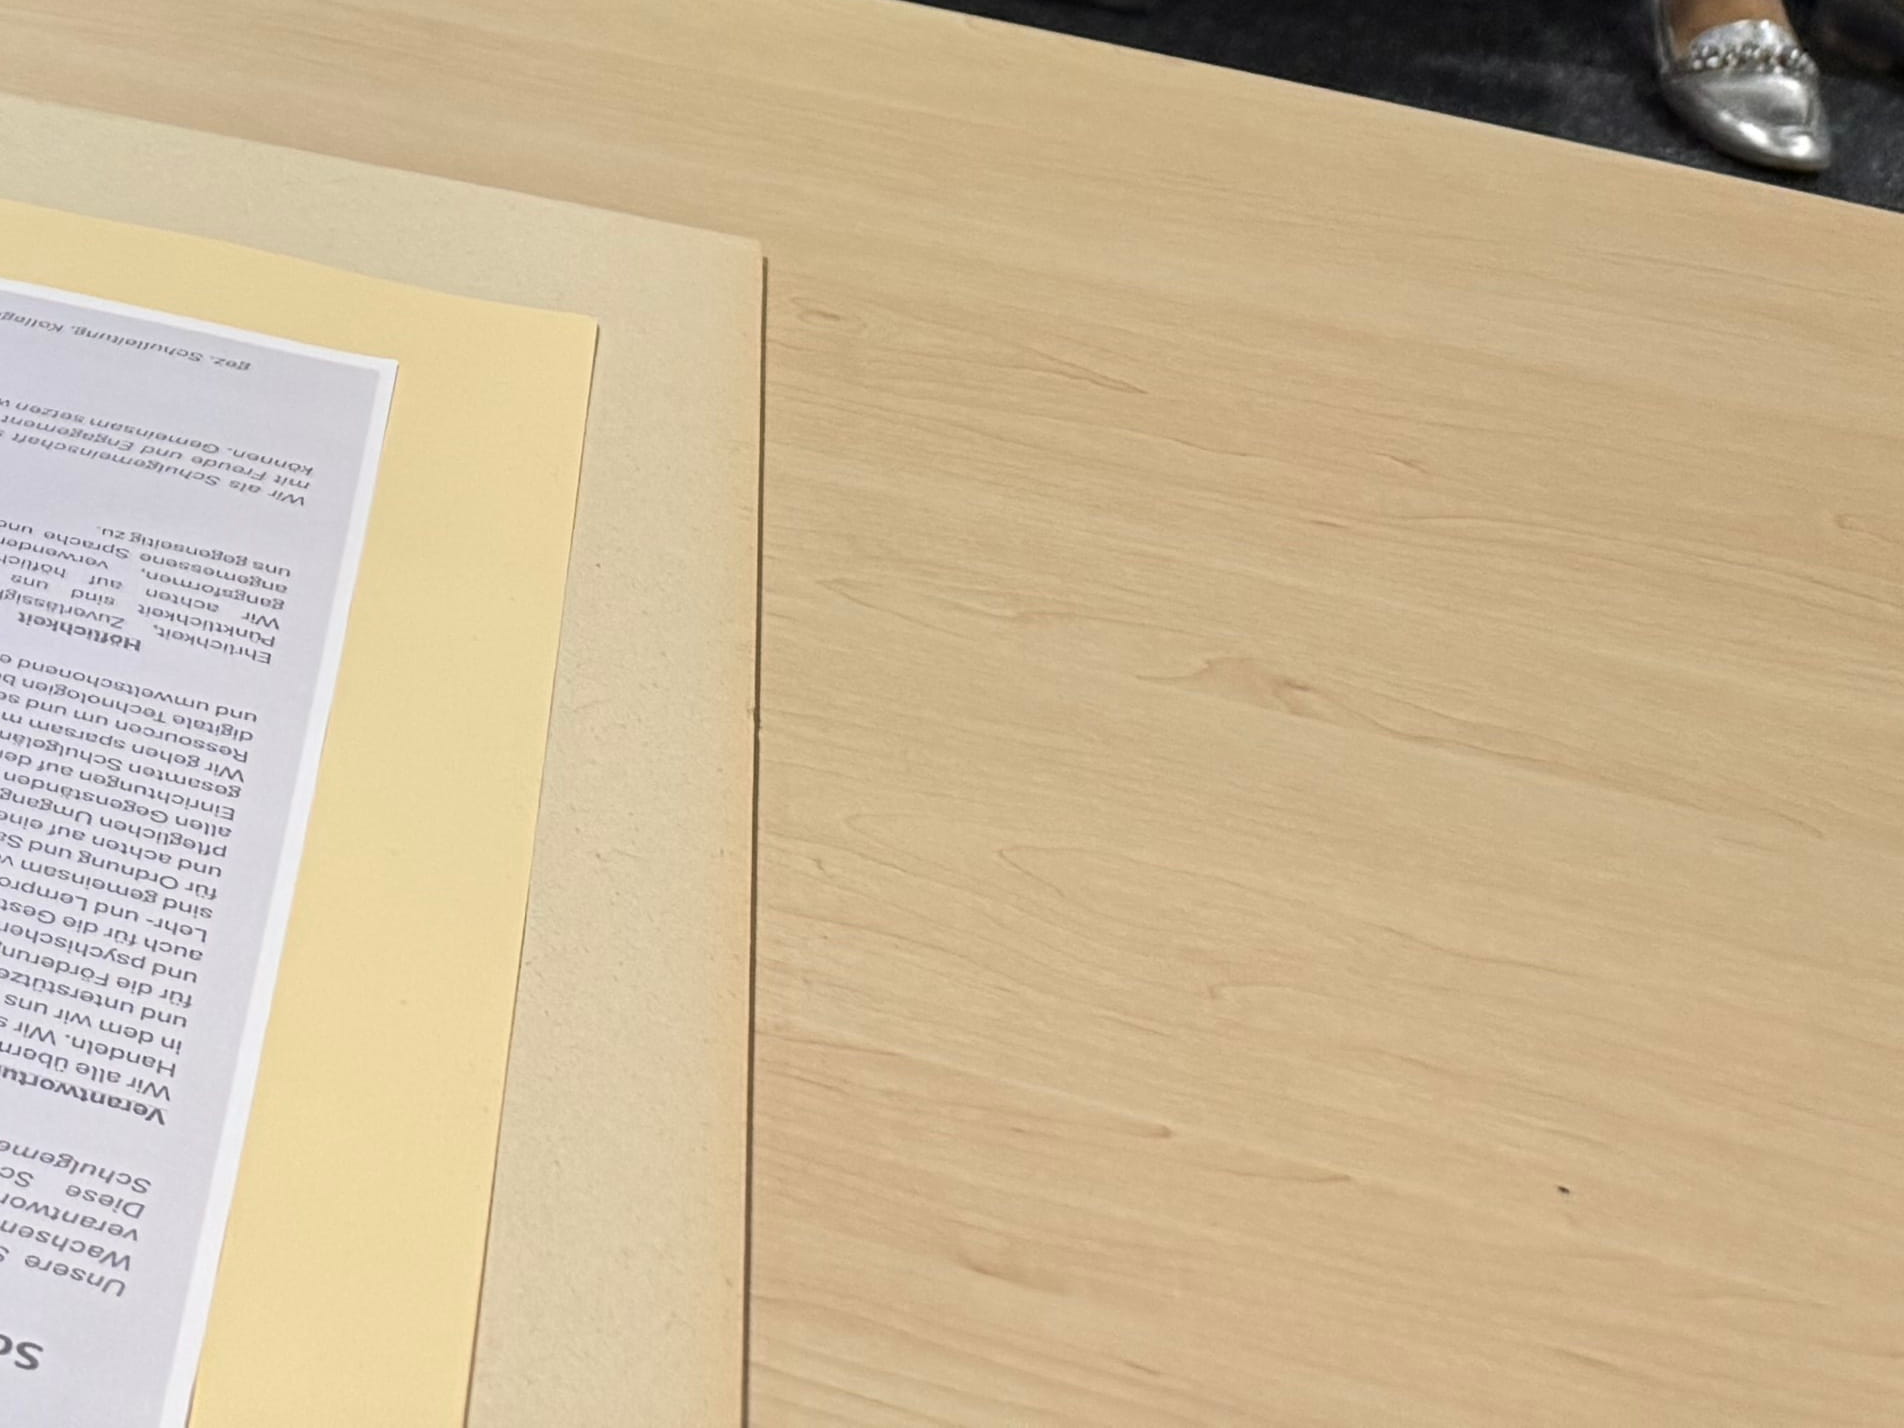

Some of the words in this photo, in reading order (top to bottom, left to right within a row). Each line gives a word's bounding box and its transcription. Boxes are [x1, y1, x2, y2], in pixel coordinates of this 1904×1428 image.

[17, 611, 142, 652] Höflichkeit
[22, 677, 167, 724] Technologien
[25, 698, 67, 716] und
[73, 709, 109, 727] um
[172, 714, 254, 743] digitale
[28, 718, 126, 750] sparsam
[115, 719, 248, 764] Ressourcen
[131, 743, 201, 768] gehen
[36, 760, 74, 777] auf
[204, 762, 245, 784] Wir
[128, 763, 242, 799] gesamten
[3, 771, 169, 824] Gegenständen
[79, 770, 236, 822] Einrichtungen
[47, 824, 86, 841] auf
[99, 816, 228, 858] pfleglichen
[175, 815, 232, 838] allen
[28, 839, 73, 860] und
[92, 835, 172, 865] achten
[77, 849, 179, 890] Ordnung
[176, 858, 222, 878] und
[20, 859, 159, 904] gemeinsam
[184, 881, 217, 901] für
[93, 901, 139, 923] und
[162, 896, 213, 919] sind
[62, 916, 99, 935] die
[103, 927, 137, 947] für
[145, 918, 208, 944] Lehr-
[143, 937, 204, 961] auch
[151, 962, 198, 984] und
[116, 976, 153, 997] die
[3, 993, 48, 1016] uns
[158, 988, 192, 1009] für
[53, 1008, 92, 1029] wir
[140, 1006, 187, 1028] und
[13, 1021, 56, 1047] Wir
[98, 1019, 154, 1045] dem
[65, 1034, 176, 1078] Handeln.
[160, 1036, 183, 1056] in
[75, 1062, 122, 1084] alle
[126, 1076, 171, 1102] Wir
[65, 1184, 146, 1219] Diese
[24, 1255, 126, 1297] Unsere
